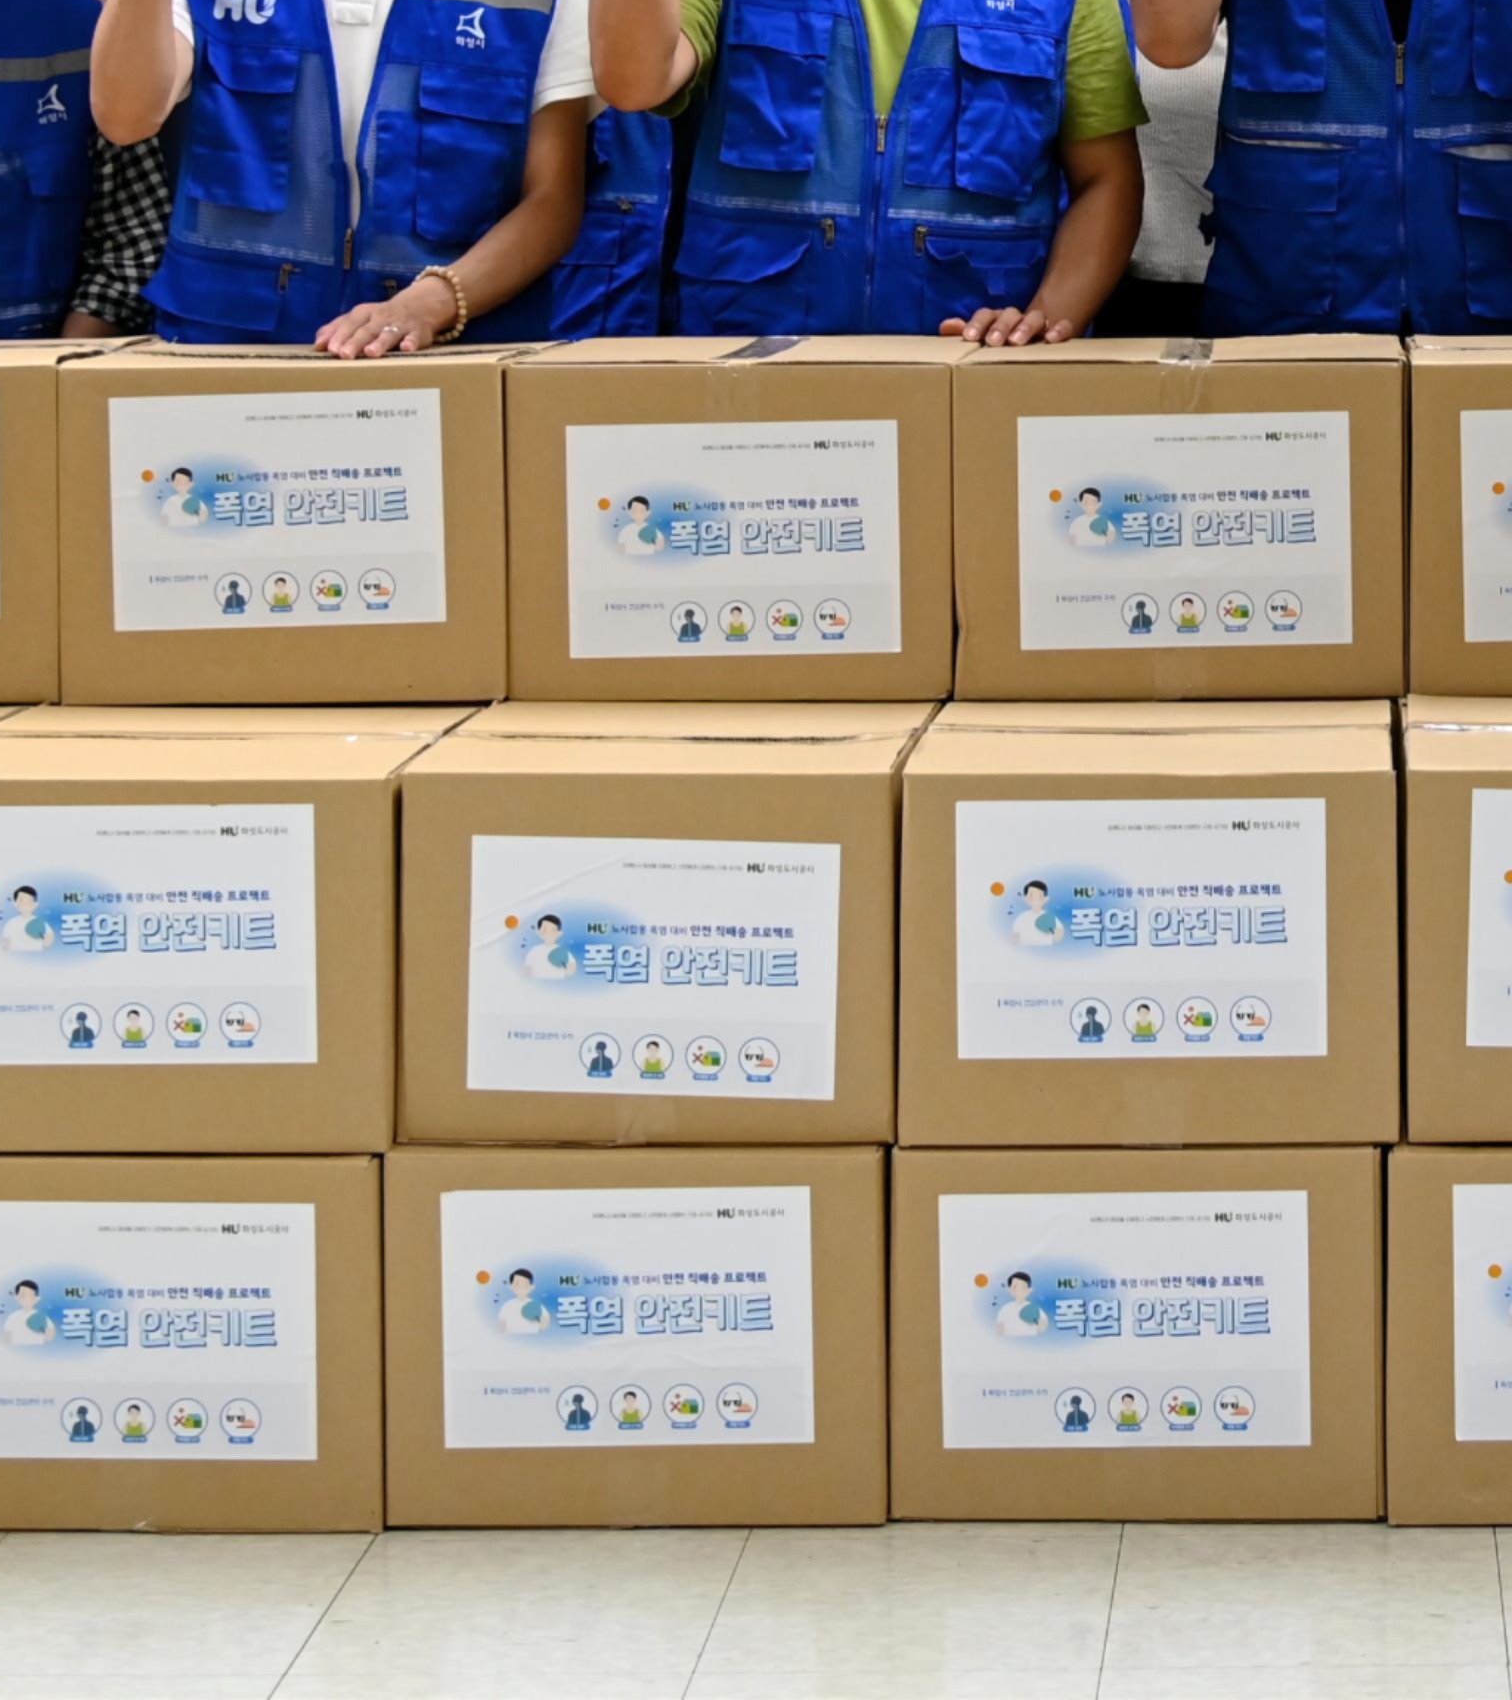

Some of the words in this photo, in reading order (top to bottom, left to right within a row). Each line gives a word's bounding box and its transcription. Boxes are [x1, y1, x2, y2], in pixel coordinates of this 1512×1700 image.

[355, 408, 374, 420] HU
[1264, 431, 1283, 442] HU
[215, 472, 235, 483] HU
[307, 468, 328, 481] 안전
[330, 466, 360, 480] 직배송
[362, 465, 403, 479] 프로젝트
[1123, 492, 1143, 504] HU
[1216, 489, 1237, 502] 안전
[1239, 488, 1269, 502] 직배송
[1270, 488, 1311, 501] 프로젝트
[212, 489, 275, 529] 폭염
[282, 482, 409, 526] 안전키트
[1120, 510, 1182, 549] 폭염
[1190, 505, 1316, 547] 안전키트
[668, 518, 731, 557] 폭염
[738, 513, 865, 556] 안전키트
[59, 911, 128, 954] 폭염
[136, 908, 277, 953] 안전키트
[1069, 906, 1138, 949] 폭염
[1147, 902, 1288, 948] 안전키트
[582, 943, 650, 984] 폭염
[660, 944, 799, 987] 안전키트
[1214, 1211, 1234, 1223] HU
[1056, 1277, 1078, 1290] HU
[1159, 1275, 1182, 1289] 안전
[1185, 1274, 1218, 1289] 직배송
[1220, 1274, 1266, 1288] 프로젝트
[60, 1307, 129, 1348] 폭염
[137, 1305, 277, 1349] 안전키트
[555, 1294, 624, 1337] 폭염
[633, 1289, 774, 1335] 안전키트
[1053, 1297, 1122, 1339] 폭염
[1131, 1293, 1271, 1338] 안전키트
